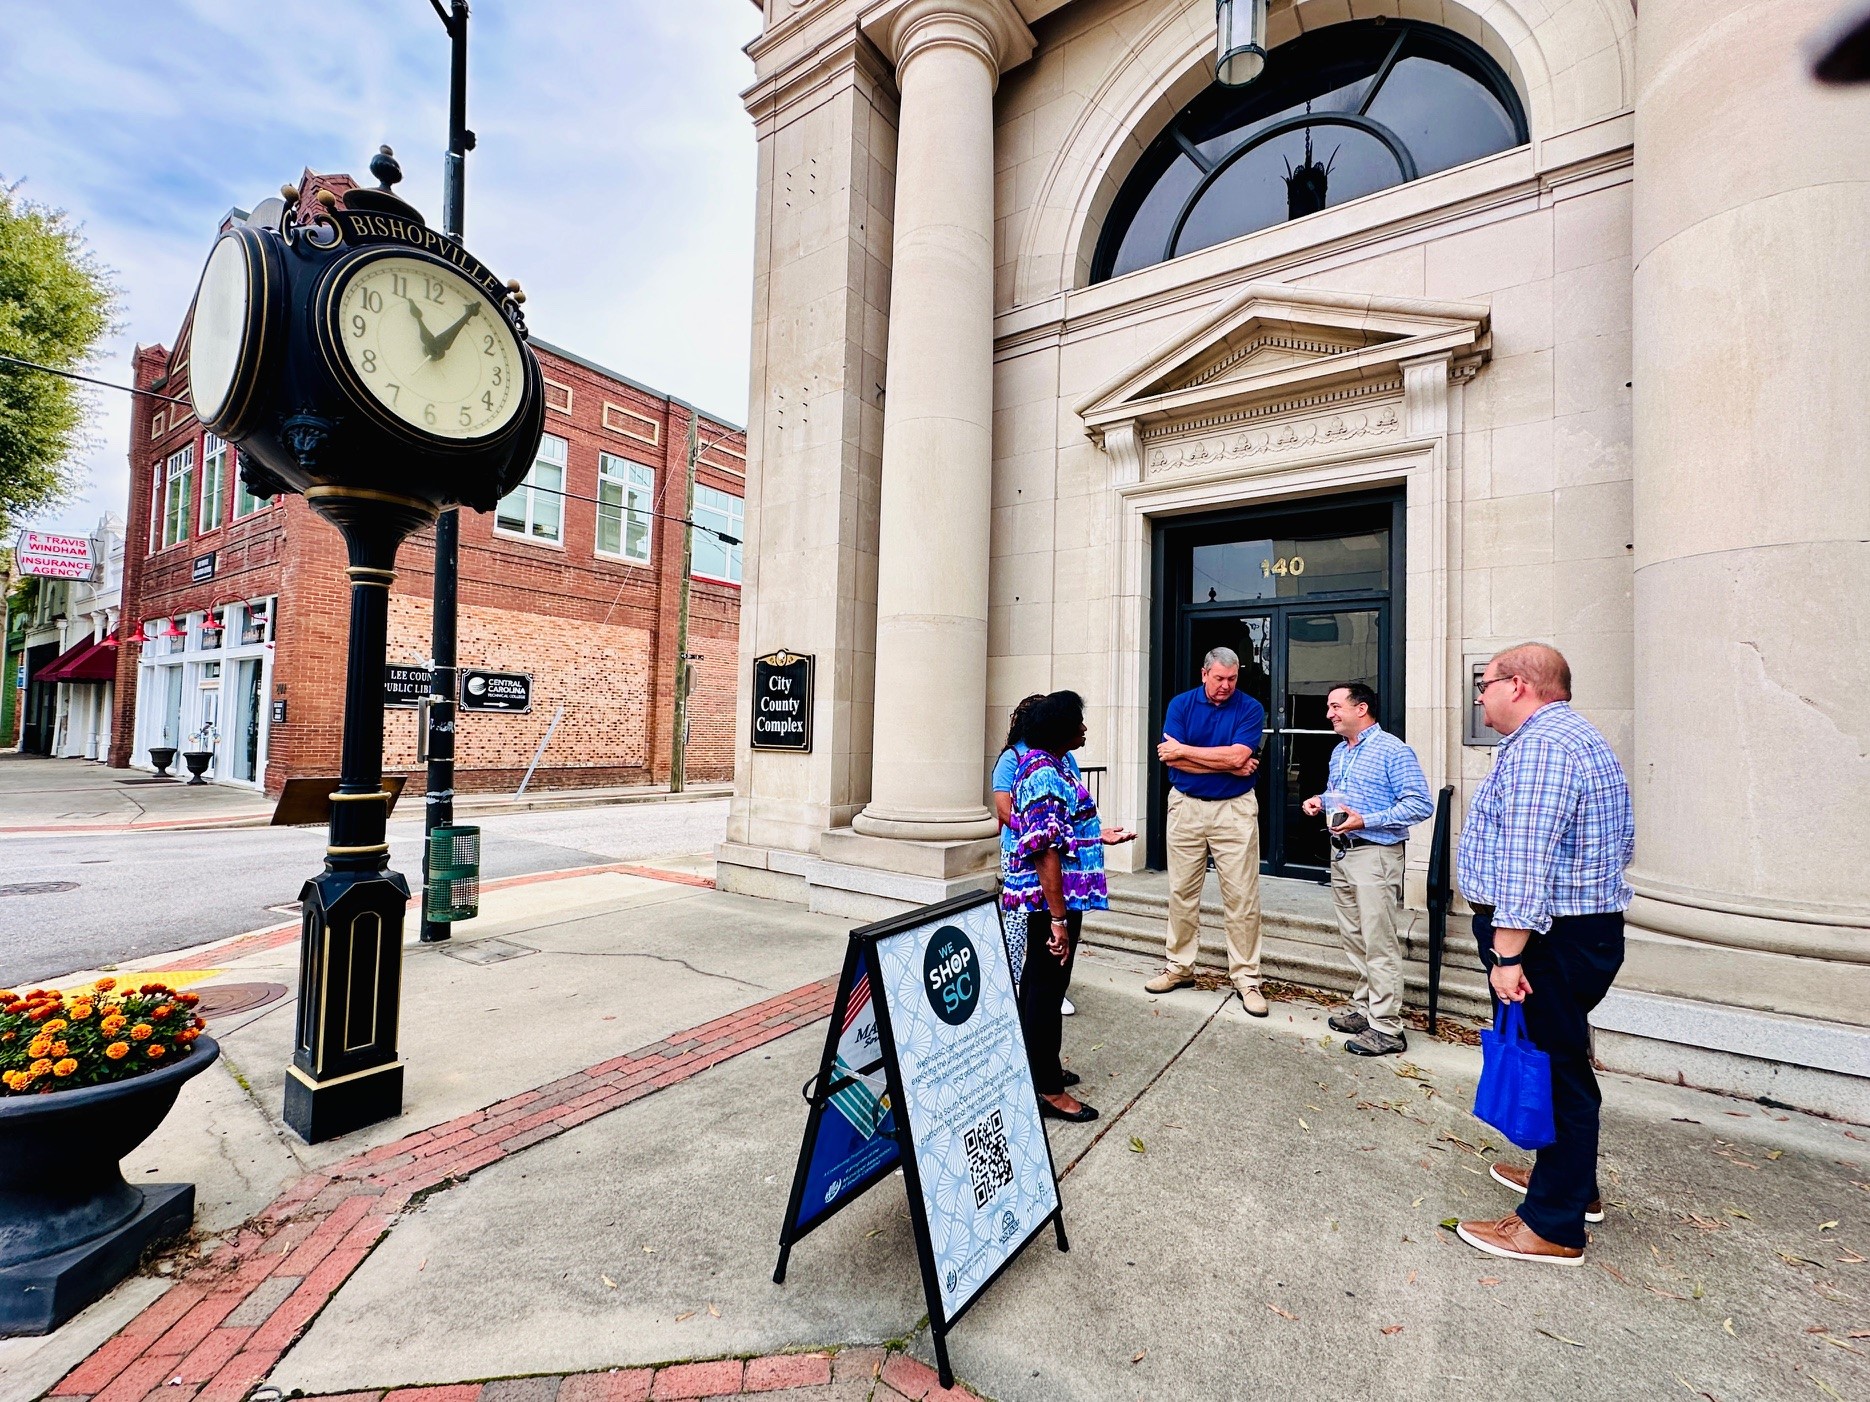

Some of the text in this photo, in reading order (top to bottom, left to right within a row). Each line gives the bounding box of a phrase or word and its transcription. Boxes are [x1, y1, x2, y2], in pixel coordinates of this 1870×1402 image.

[350, 215, 498, 293] BISHOPVILLE
[391, 273, 408, 299] 11
[424, 278, 445, 305] 12
[361, 287, 383, 314] 10
[352, 314, 367, 338] 9
[483, 334, 495, 356] 2
[361, 349, 377, 373] 8
[492, 366, 502, 386] 3
[385, 383, 401, 407] 7
[481, 390, 494, 412] 4
[424, 403, 437, 425] 6
[458, 406, 472, 427] 5
[29, 543, 87, 556] WINDHAM
[46, 536, 86, 548] TRAVIS
[22, 556, 91, 570] INSURANCE
[32, 566, 82, 577] AGENCY
[1260, 556, 1305, 578] 140
[391, 670, 408, 680] LEE
[488, 679, 522, 688] CENTRAL
[769, 675, 792, 694] City
[384, 682, 413, 693] UBLIC
[487, 686, 526, 695] CAROLINA
[760, 697, 800, 715] County
[756, 717, 804, 736] Complex
[938, 941, 955, 959] WE
[929, 947, 971, 990] SHOP
[942, 972, 973, 1014] SC
[910, 1064, 937, 1088] exploring
[936, 1058, 947, 1070] the
[925, 1072, 942, 1089] small
[951, 1071, 963, 1085] and
[942, 1098, 959, 1116] South
[943, 1115, 953, 1128] for
